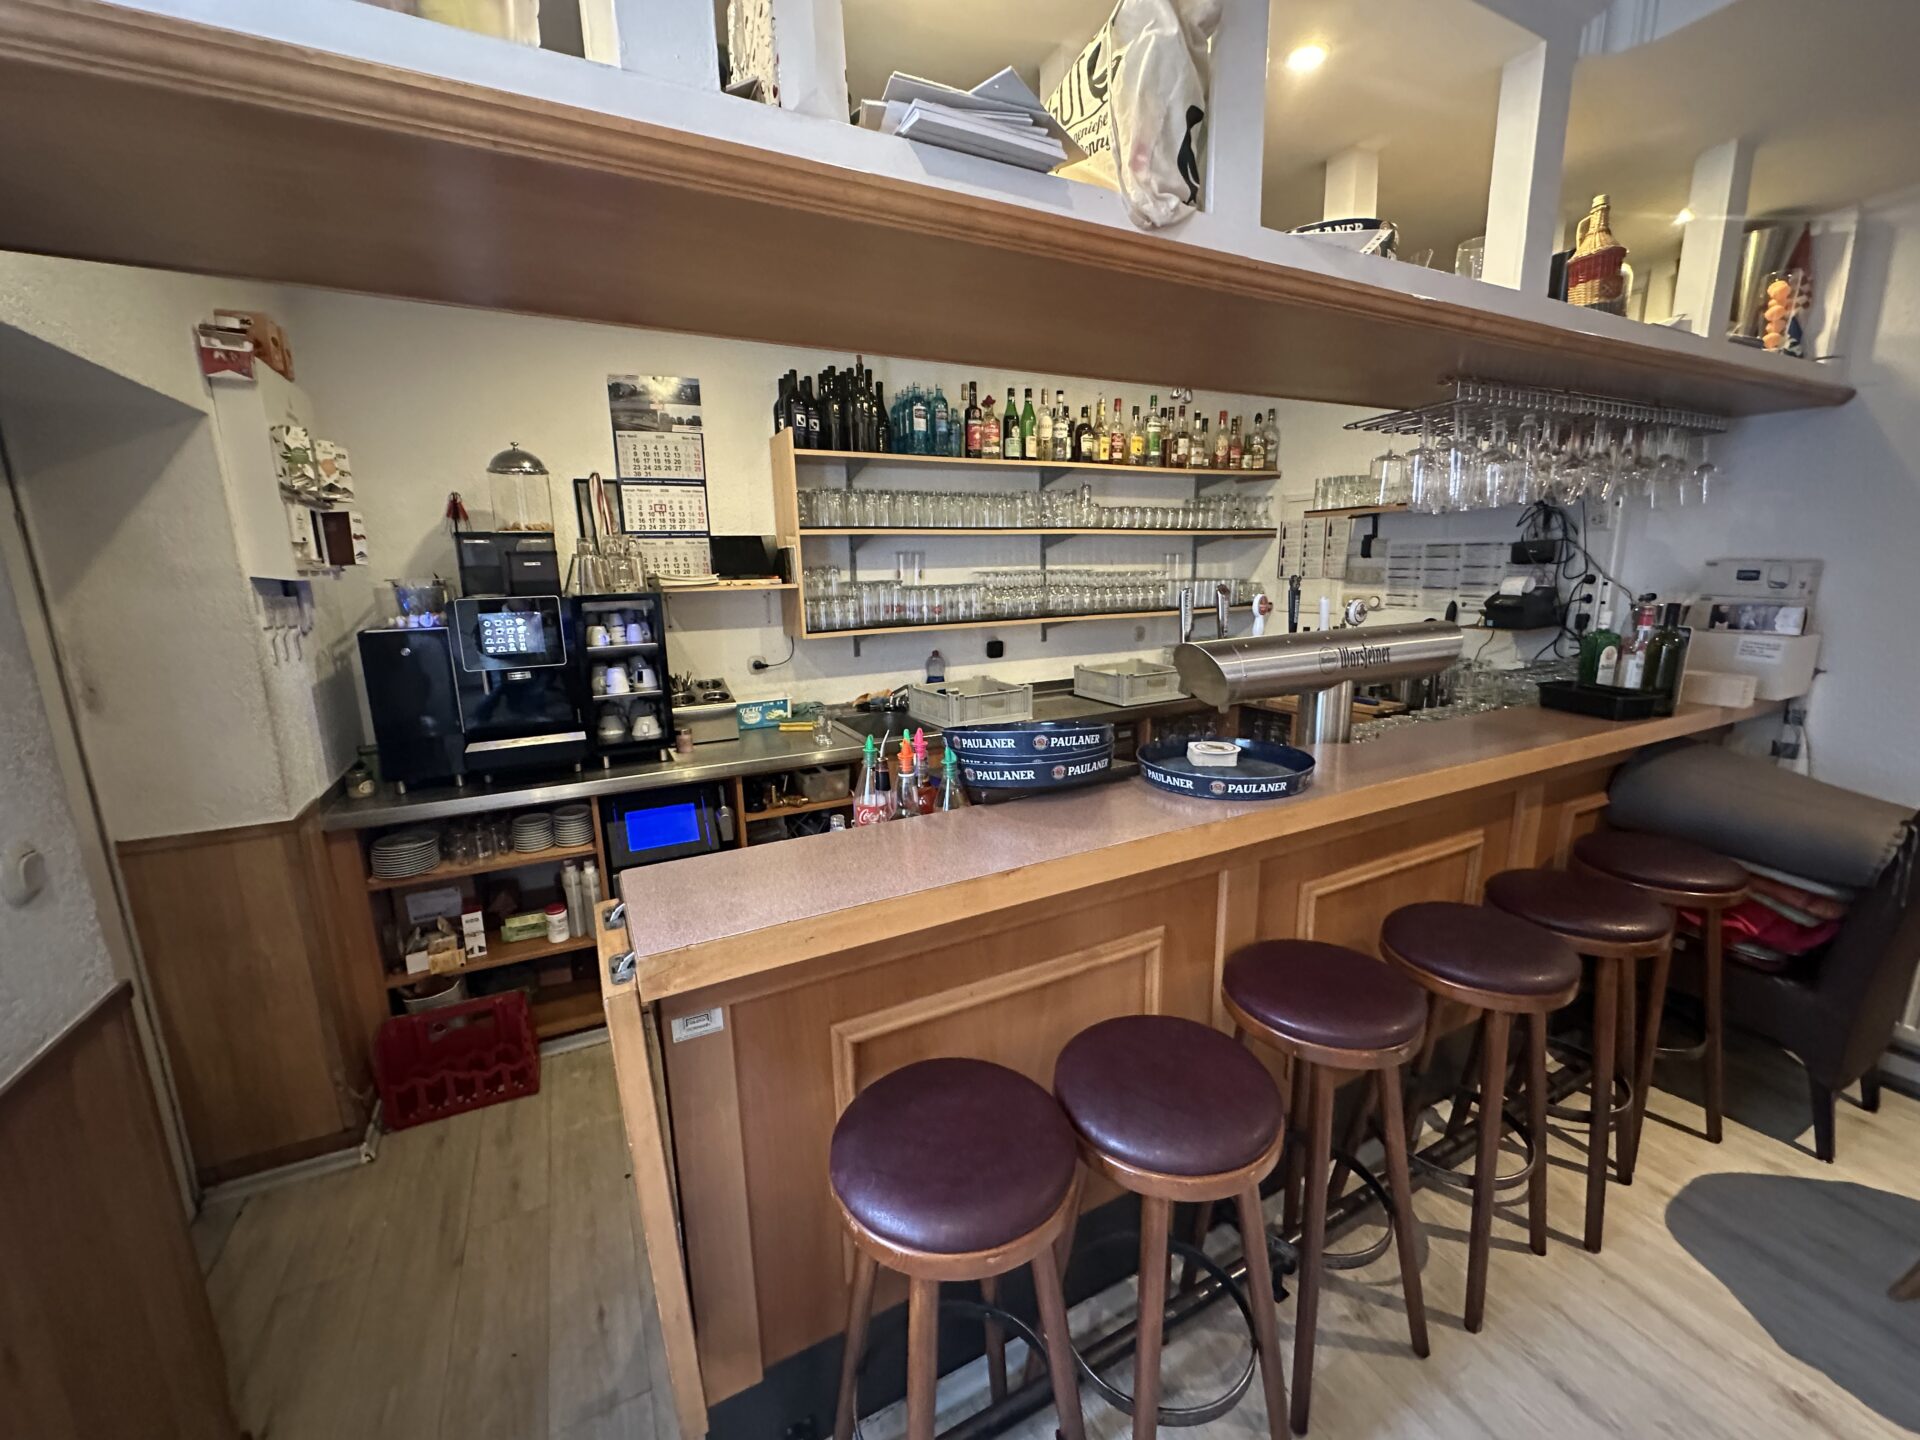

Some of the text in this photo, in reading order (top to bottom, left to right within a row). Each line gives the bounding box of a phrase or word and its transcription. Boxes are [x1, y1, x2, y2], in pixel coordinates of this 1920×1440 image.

[1338, 643, 1390, 669] Warsteiner
[962, 734, 1100, 749] PAULANER PAULANER
[976, 758, 1109, 781] PAULANER PAULANER
[1147, 769, 1287, 794] PAULANER PAULANER
